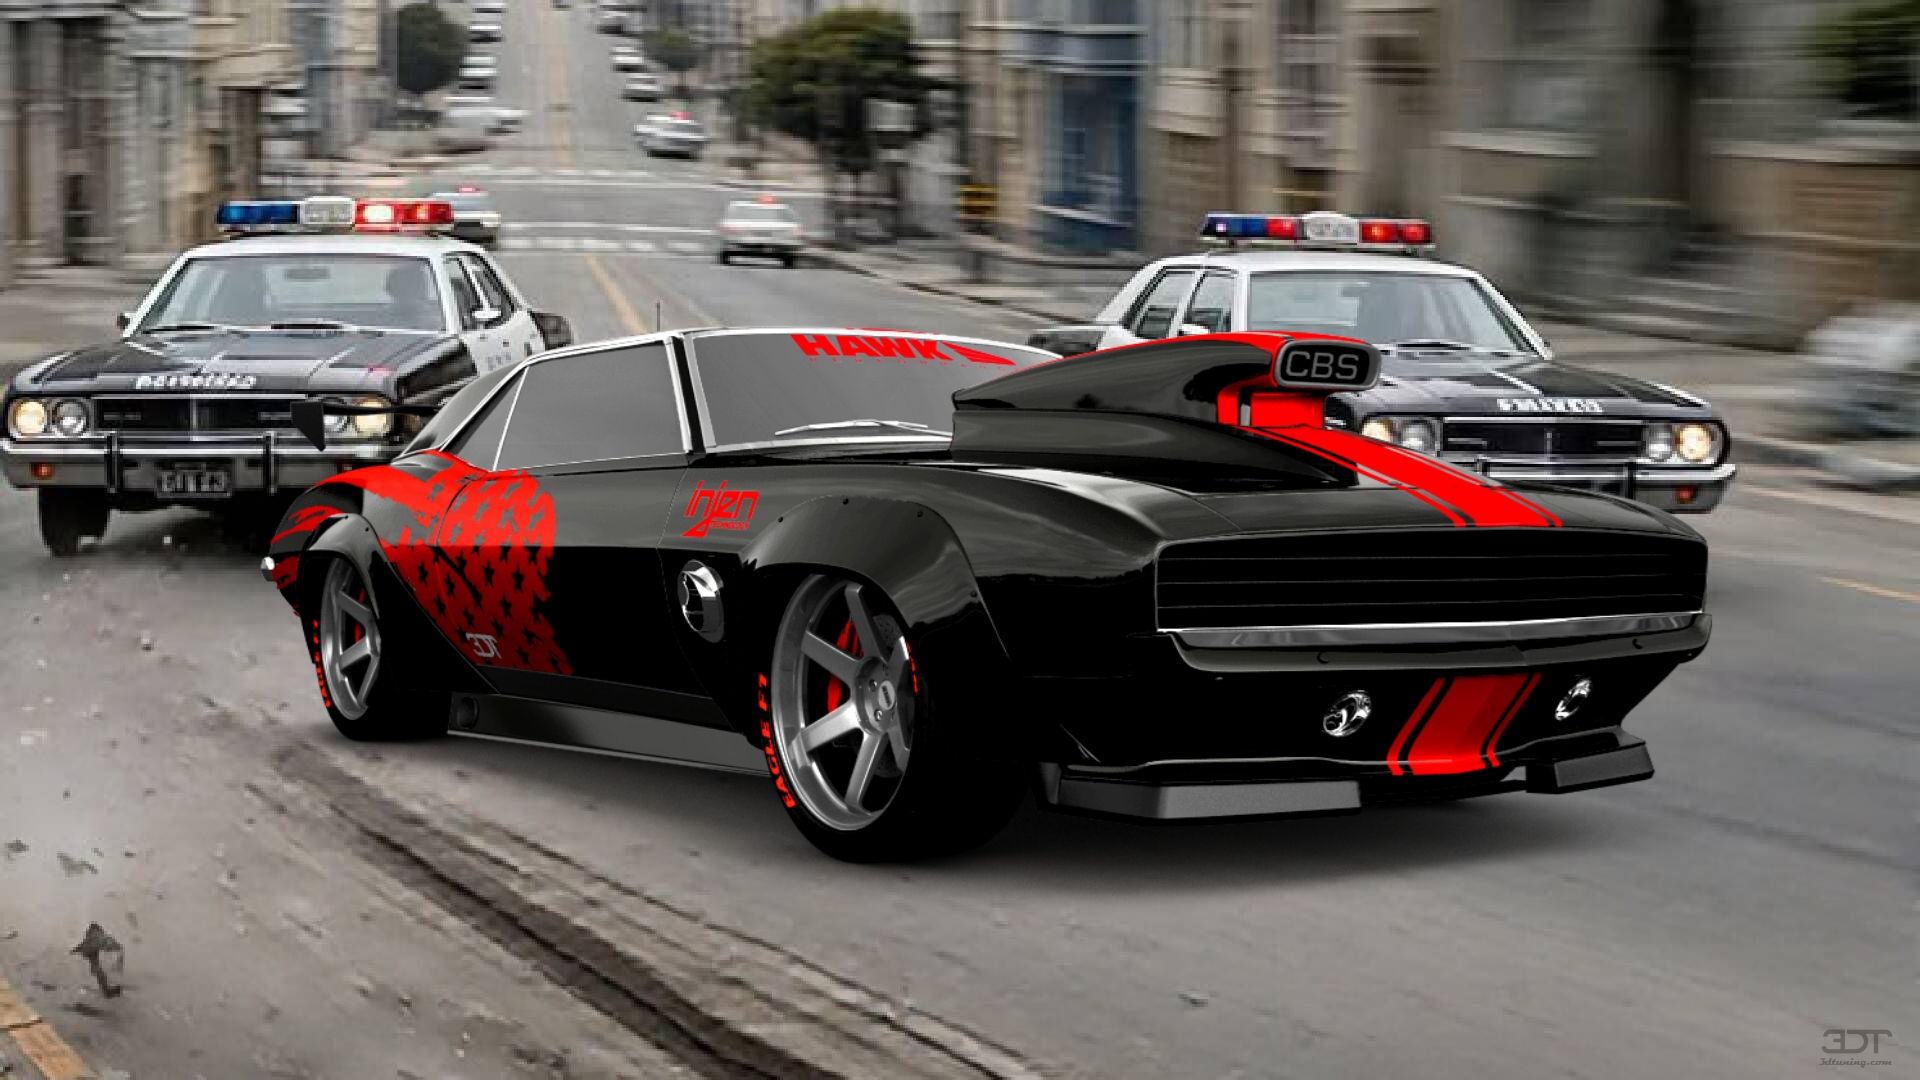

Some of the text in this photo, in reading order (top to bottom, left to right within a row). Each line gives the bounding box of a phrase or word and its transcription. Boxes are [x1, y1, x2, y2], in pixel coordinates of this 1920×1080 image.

[790, 334, 954, 361] HAWK
[1286, 350, 1360, 380] CBS
[758, 673, 797, 809] EAGLE F1
